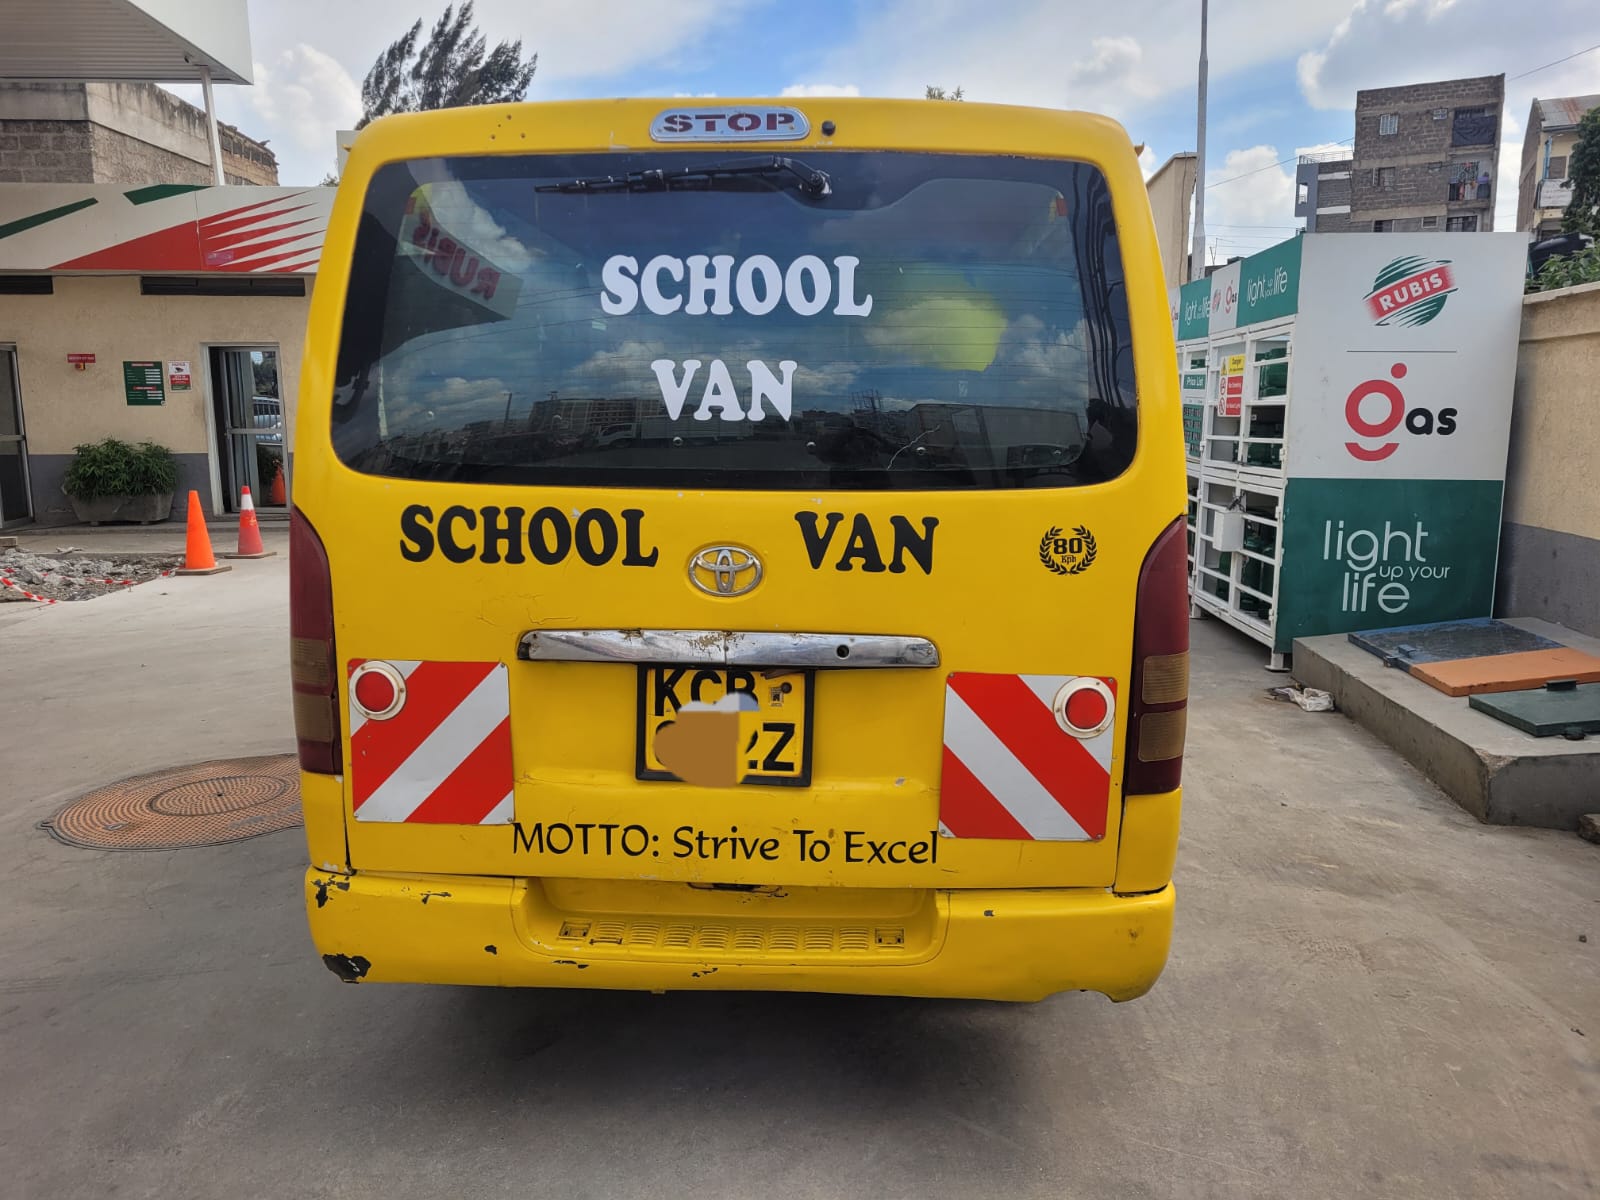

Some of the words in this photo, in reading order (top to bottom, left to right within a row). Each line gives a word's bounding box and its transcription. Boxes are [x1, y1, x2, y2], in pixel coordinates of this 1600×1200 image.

[663, 113, 795, 132] STOP
[600, 254, 873, 317] SCHOOL
[1273, 266, 1288, 293] life
[650, 359, 798, 422] VAN
[1345, 362, 1458, 462] gas
[400, 504, 658, 568] SCHOOL
[795, 510, 939, 575] VAN
[1053, 537, 1083, 554] 80
[1322, 520, 1428, 572] light
[1342, 572, 1410, 613] life
[1379, 565, 1404, 581] up
[1409, 566, 1451, 581] your
[512, 822, 659, 858] MOTTO:
[673, 825, 780, 861] Strive
[792, 829, 831, 863] To
[844, 830, 938, 864] Excel
